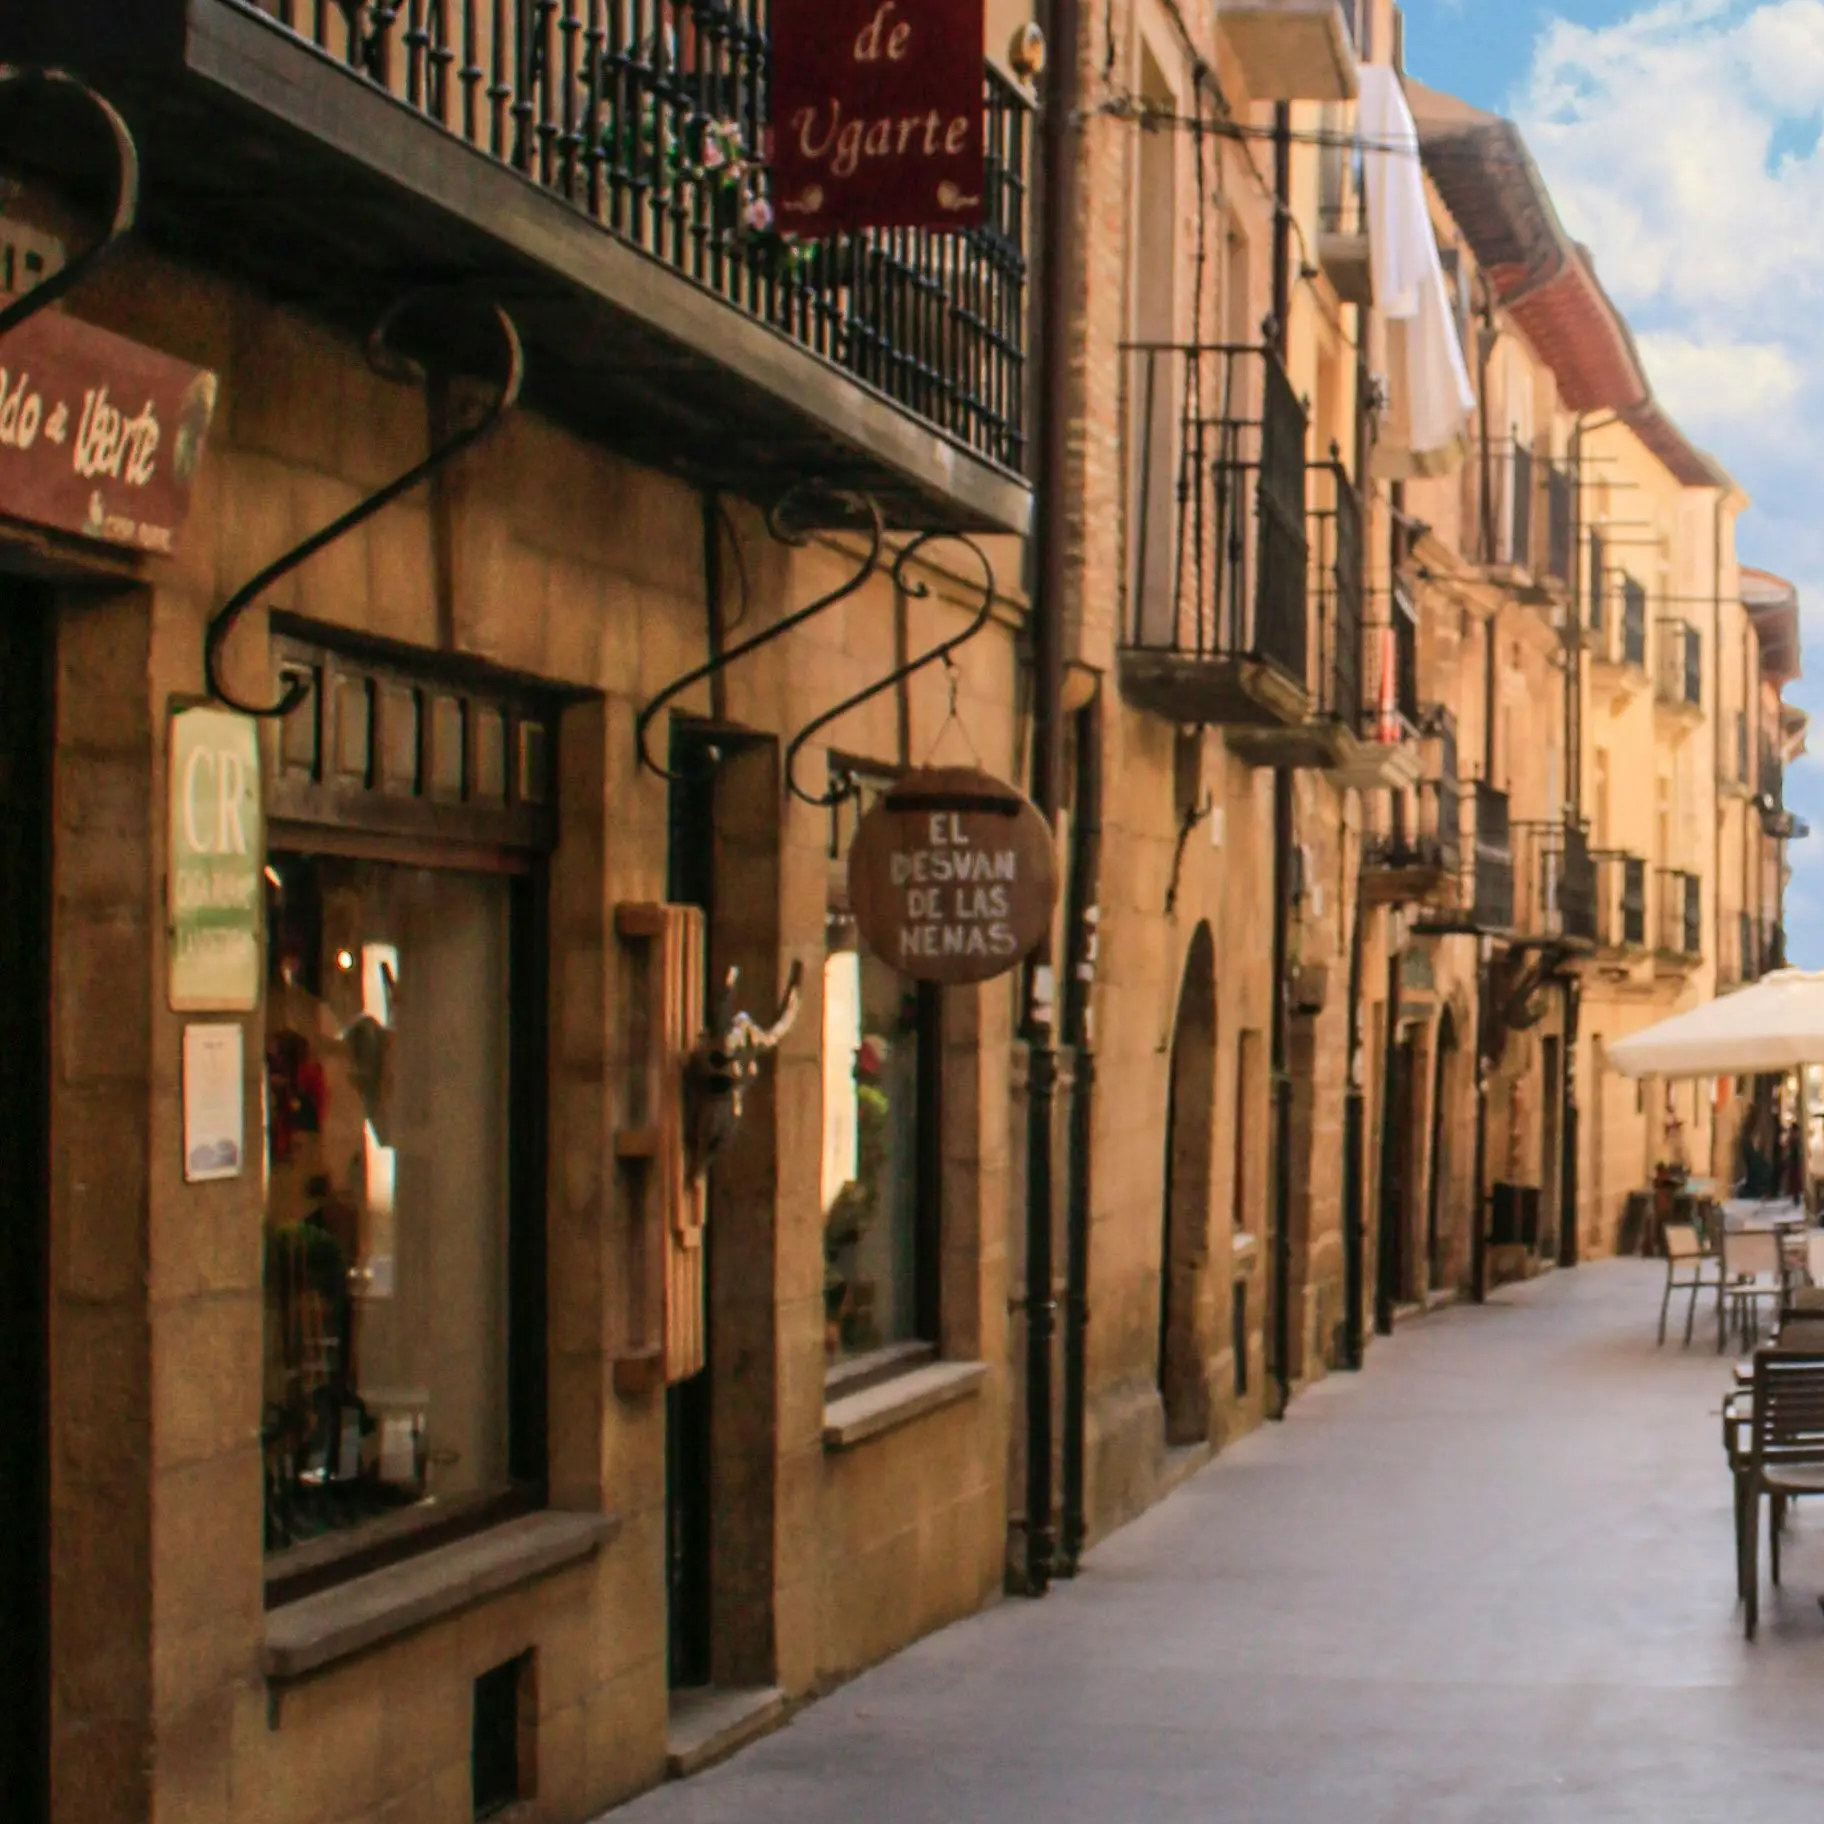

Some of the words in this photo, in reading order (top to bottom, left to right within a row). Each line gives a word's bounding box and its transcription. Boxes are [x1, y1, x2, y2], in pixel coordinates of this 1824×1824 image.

[854, 1, 912, 61] de
[791, 97, 969, 178] Ugarte
[183, 743, 247, 856] CR
[930, 813, 968, 845] EL
[891, 850, 1015, 884] DESVAN
[907, 886, 944, 920] DE
[957, 885, 1007, 919] LAS
[901, 923, 1017, 956] NENAS
